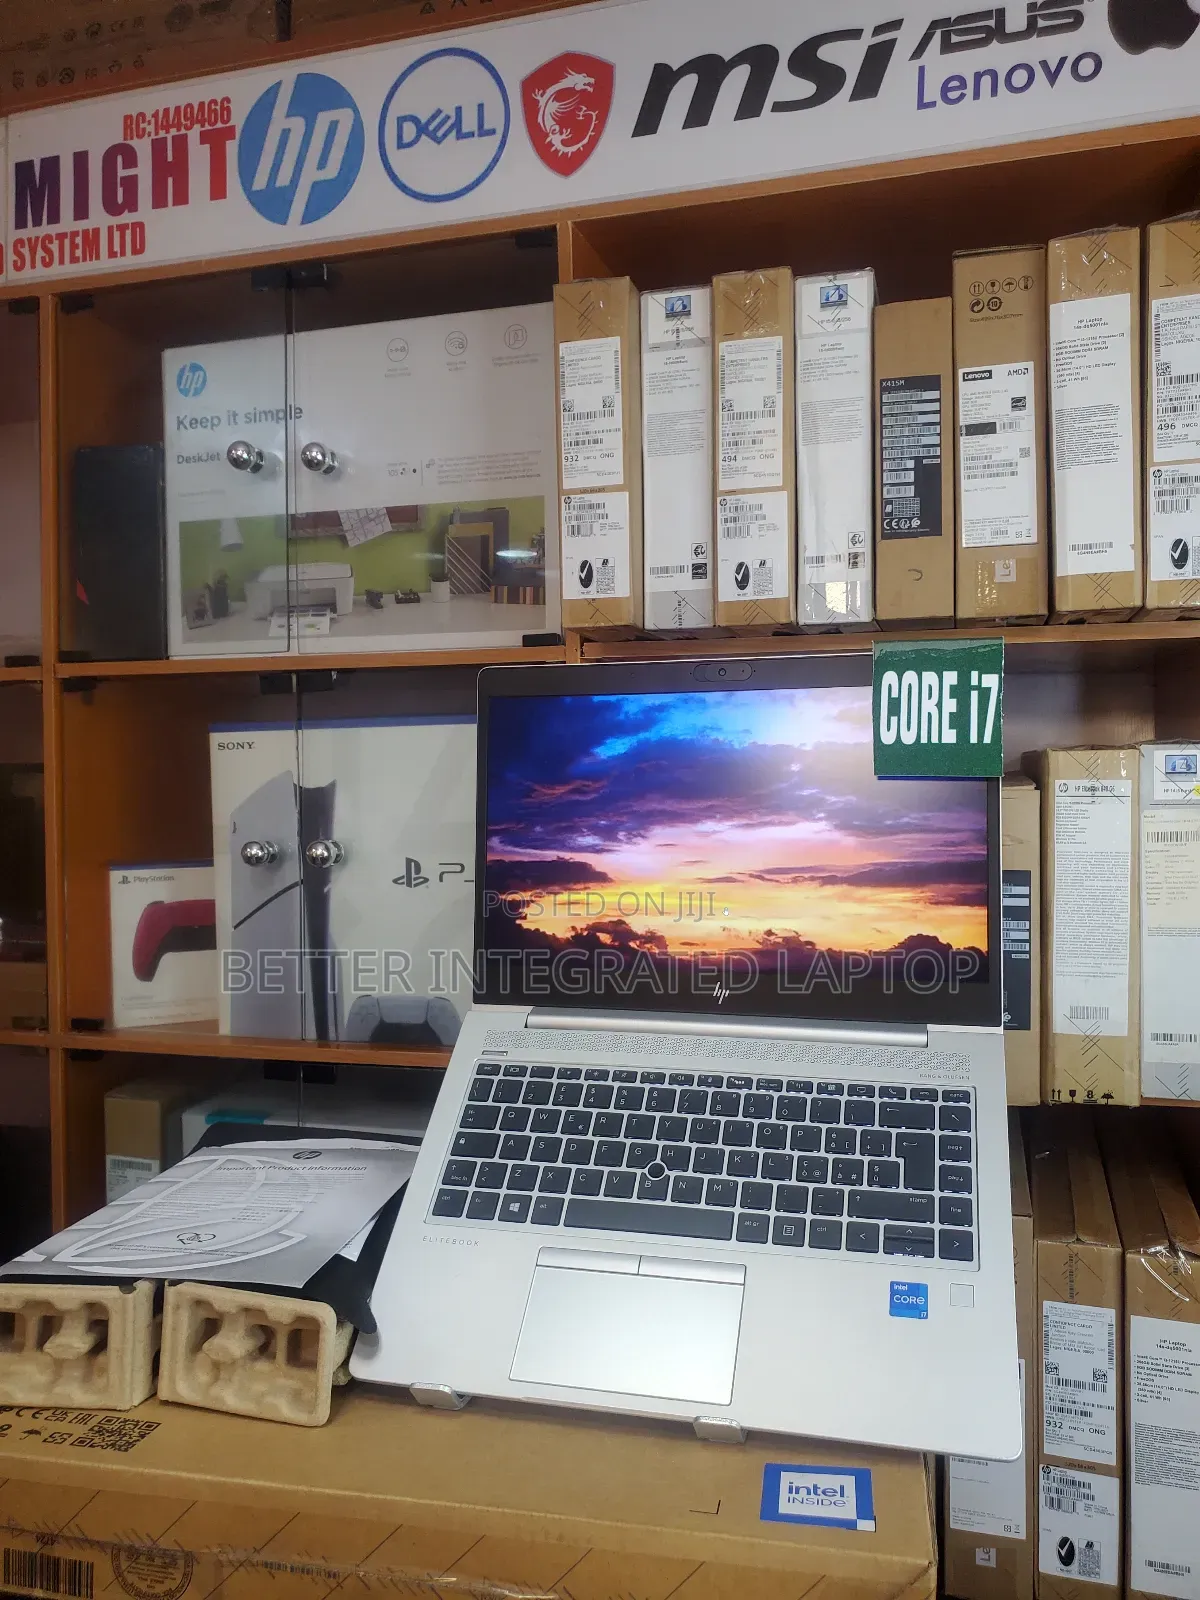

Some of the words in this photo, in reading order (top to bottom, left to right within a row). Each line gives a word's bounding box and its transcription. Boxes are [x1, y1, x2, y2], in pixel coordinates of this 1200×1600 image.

[909, 0, 1085, 61] ASUS
[631, 18, 903, 138] msi
[917, 51, 1103, 111] Lenovo
[122, 96, 232, 142] RC:1449466
[396, 102, 497, 151] DELL
[253, 73, 354, 226] hp
[15, 124, 236, 230] MIGHT
[13, 228, 101, 272] SYSTEM
[107, 221, 146, 259] LTD
[964, 372, 990, 380] Lenovo
[1007, 368, 1023, 376] AMD
[177, 362, 207, 397] hp
[882, 379, 905, 387] X415M
[176, 415, 222, 431] Keep
[227, 410, 239, 426] it
[244, 404, 304, 424] simple
[1157, 423, 1176, 431] 496
[177, 452, 221, 464] DeskJet
[563, 455, 579, 463] 932
[721, 455, 737, 463] 494
[880, 670, 958, 745] CORE
[969, 670, 999, 744] i7
[217, 741, 255, 750] SONY
[133, 874, 175, 884] PlayStation
[712, 982, 730, 1005] hp
[568, 1114, 575, 1122] E
[664, 1120, 672, 1128] Y
[507, 1139, 515, 1147] A
[569, 1143, 577, 1151] D
[635, 1147, 642, 1155] G
[700, 1152, 706, 1160] J
[734, 1155, 741, 1163] K
[768, 1158, 775, 1166] L
[514, 1169, 522, 1177] Z
[546, 1171, 554, 1179] X
[613, 1176, 619, 1184] V
[645, 1180, 652, 1188] B
[678, 1181, 686, 1189] N
[713, 1184, 722, 1192] M
[423, 1235, 480, 1247] ELITEBOOK
[893, 1283, 908, 1291] intel
[1169, 1340, 1187, 1348] Laptop
[1045, 1419, 1064, 1430] 932
[1088, 1427, 1106, 1436] ONG
[788, 1481, 845, 1498] intel
